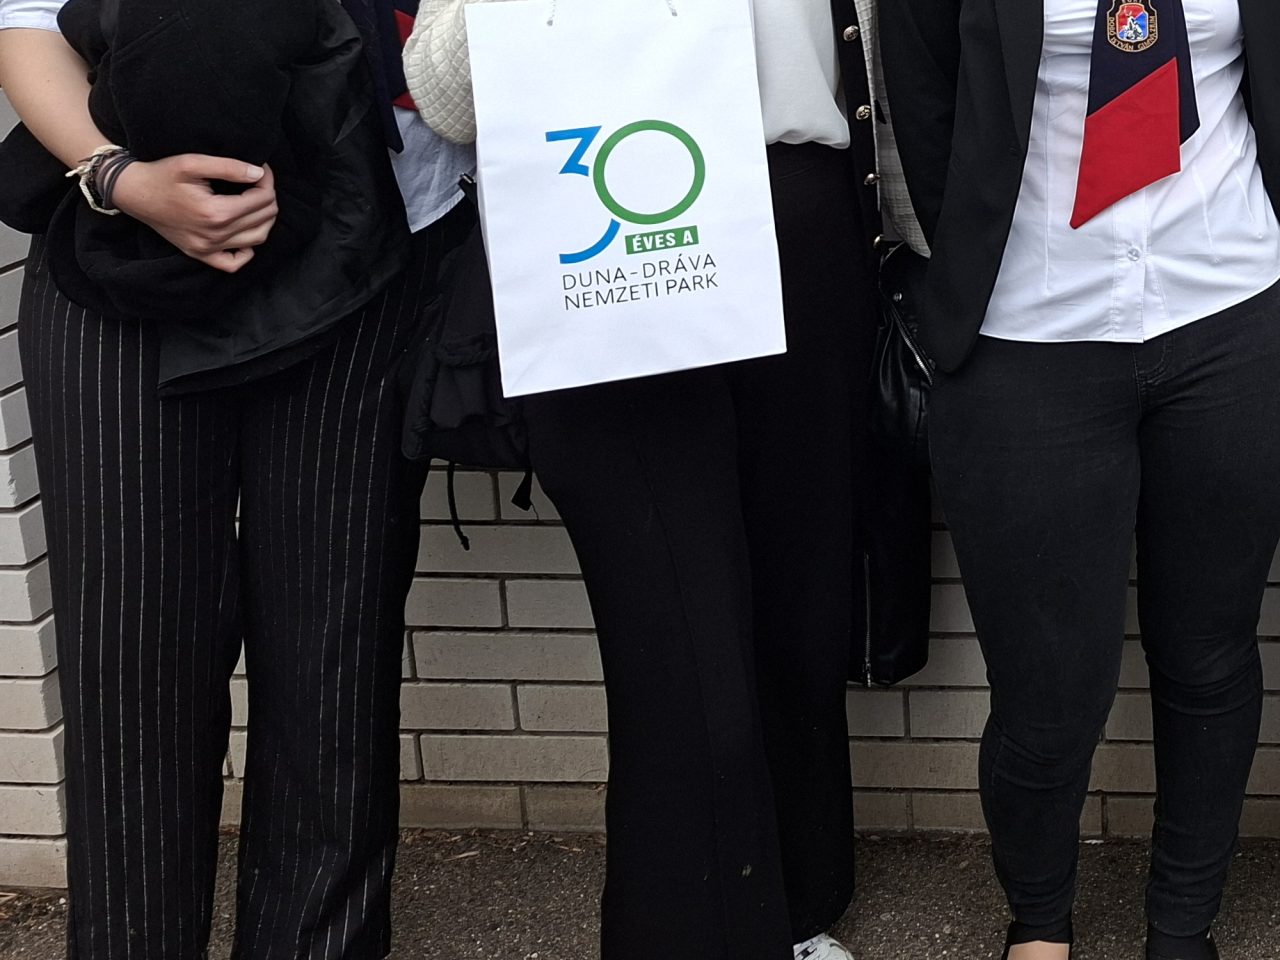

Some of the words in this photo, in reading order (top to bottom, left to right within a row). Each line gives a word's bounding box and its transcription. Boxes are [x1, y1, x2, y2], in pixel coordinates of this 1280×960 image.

[545, 119, 706, 265] 30
[632, 232, 676, 252] ÉVES
[682, 230, 694, 245] A
[564, 281, 660, 311] NEMZETI
[665, 272, 719, 296] PARK
